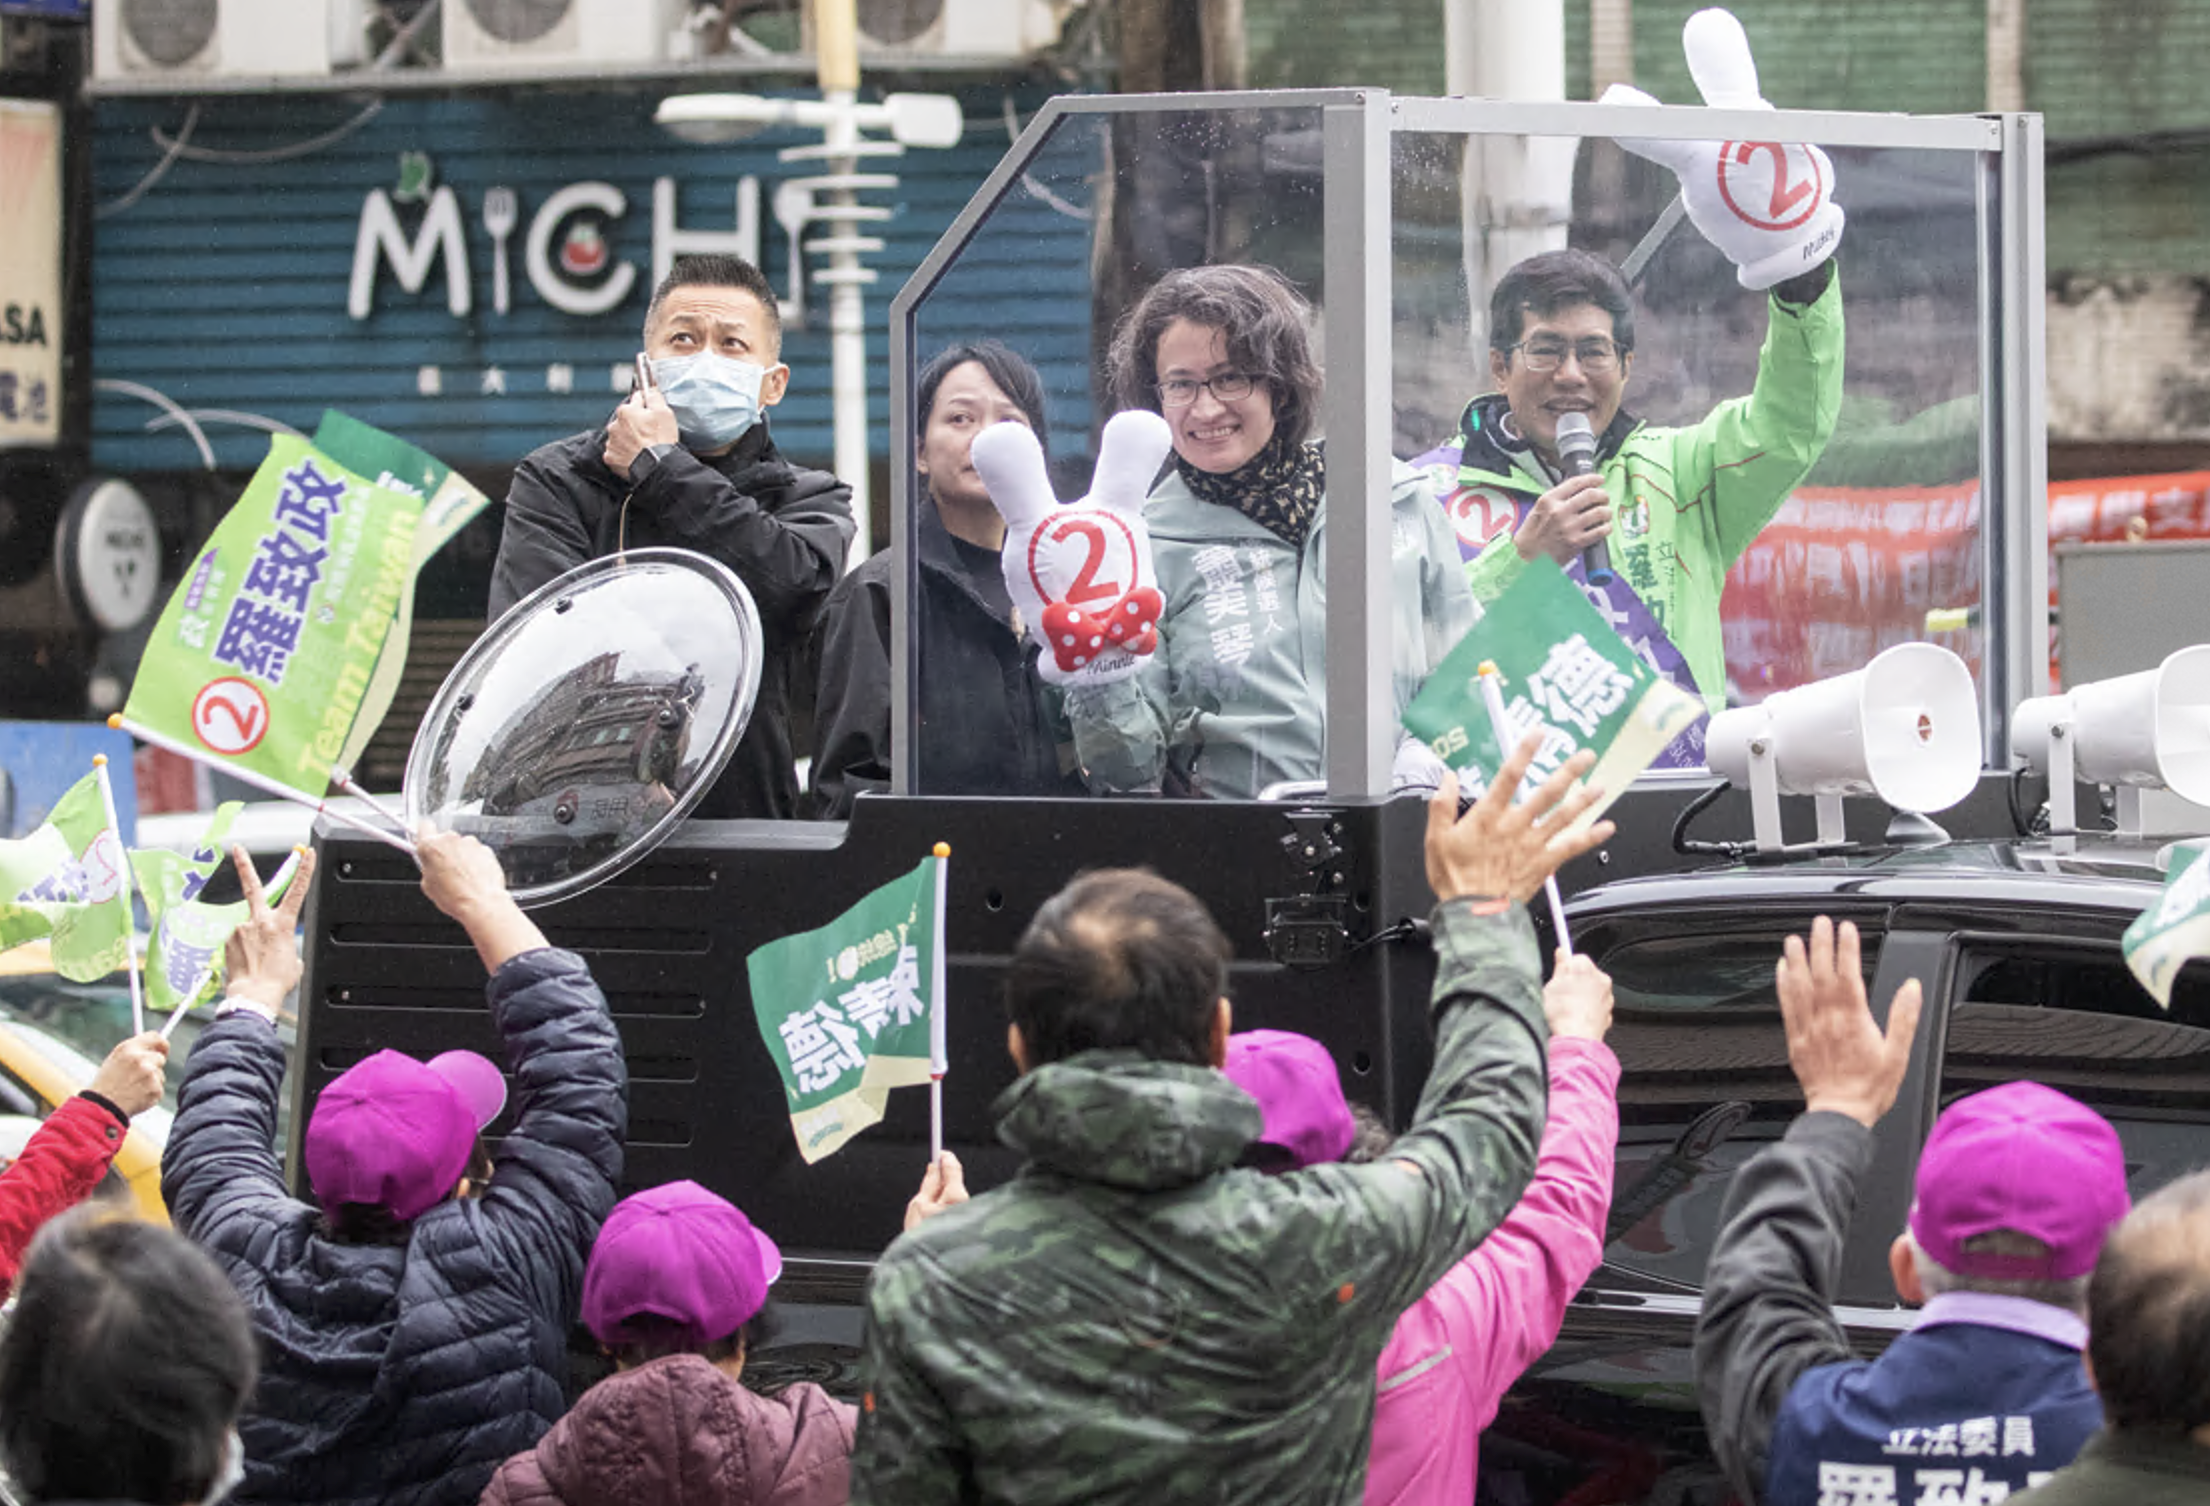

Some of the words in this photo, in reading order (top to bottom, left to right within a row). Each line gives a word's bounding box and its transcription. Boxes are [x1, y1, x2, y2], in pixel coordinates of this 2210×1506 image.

[1737, 142, 1813, 219] 2
[0, 303, 47, 344] SA
[1458, 495, 1512, 538] 2
[214, 459, 346, 684] 羅致政
[1051, 519, 1121, 605] 2
[299, 661, 367, 777] Team
[343, 509, 420, 655] Taiwan
[1881, 1415, 2036, 1456] 立法委員
